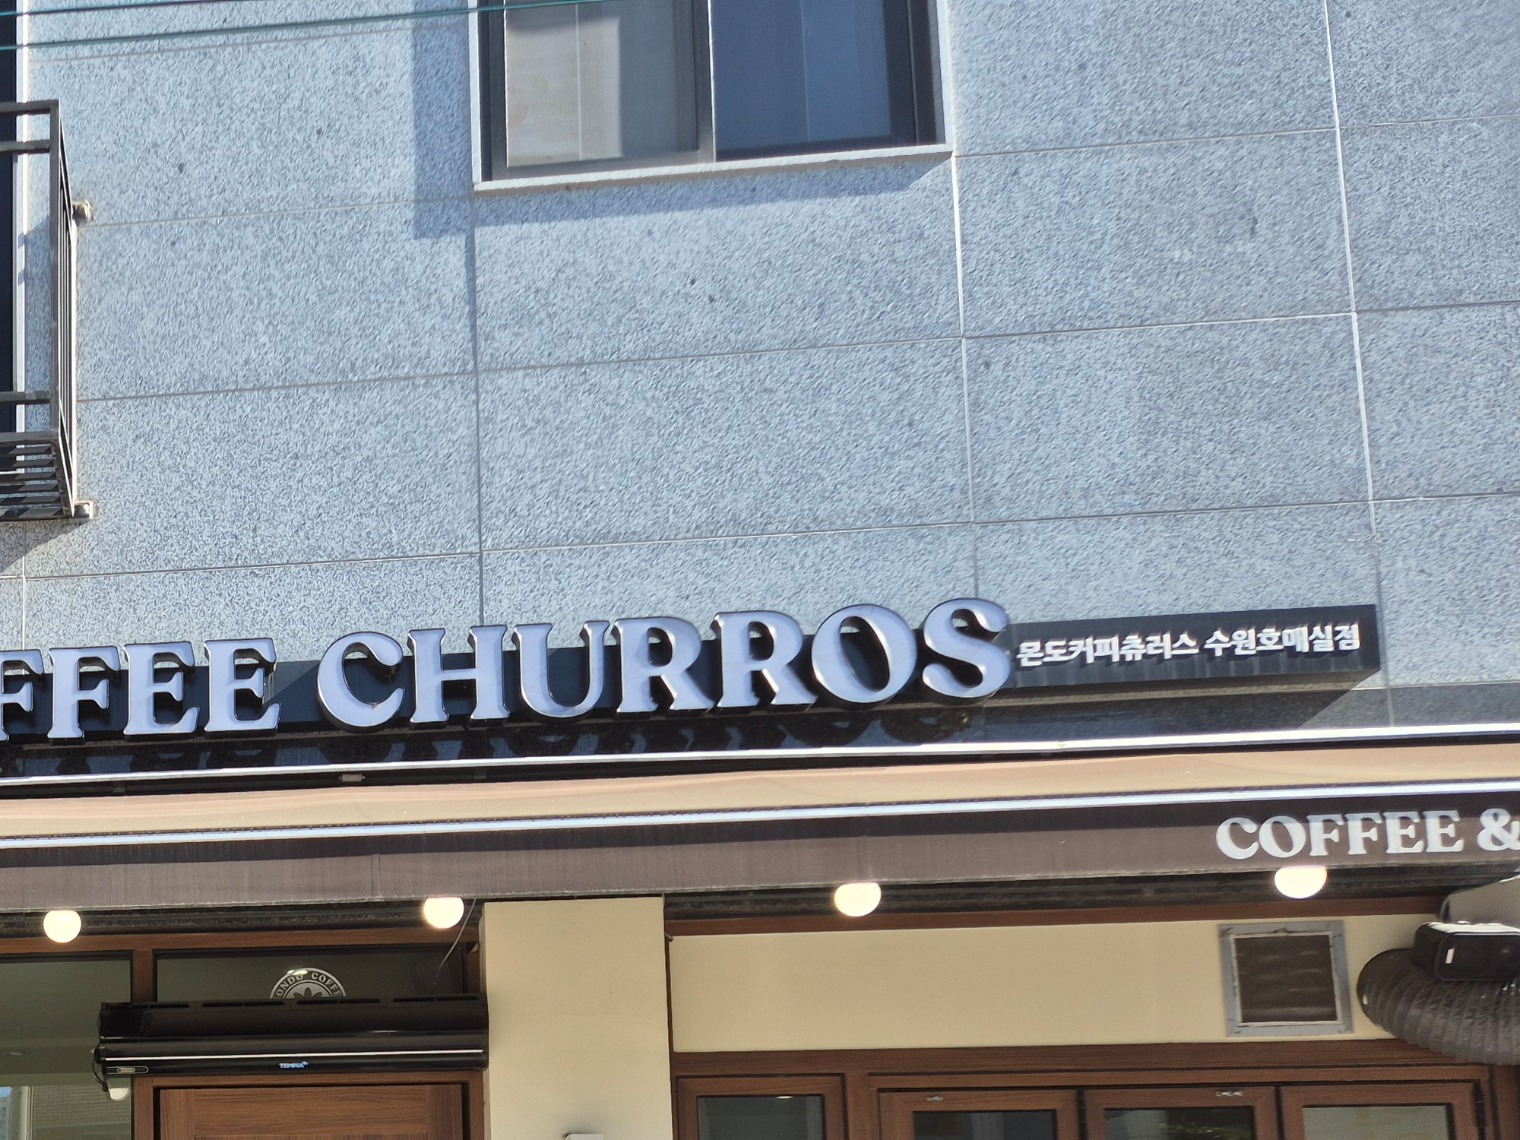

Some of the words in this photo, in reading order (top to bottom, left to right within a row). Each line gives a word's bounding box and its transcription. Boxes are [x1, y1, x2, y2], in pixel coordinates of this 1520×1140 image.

[317, 598, 1013, 729] CHURROS
[1017, 631, 1199, 668] 몬도커피츄러스
[1204, 623, 1361, 657] 수원호매실점
[1216, 809, 1465, 860] COFFEE
[311, 972, 341, 997] COFFE
